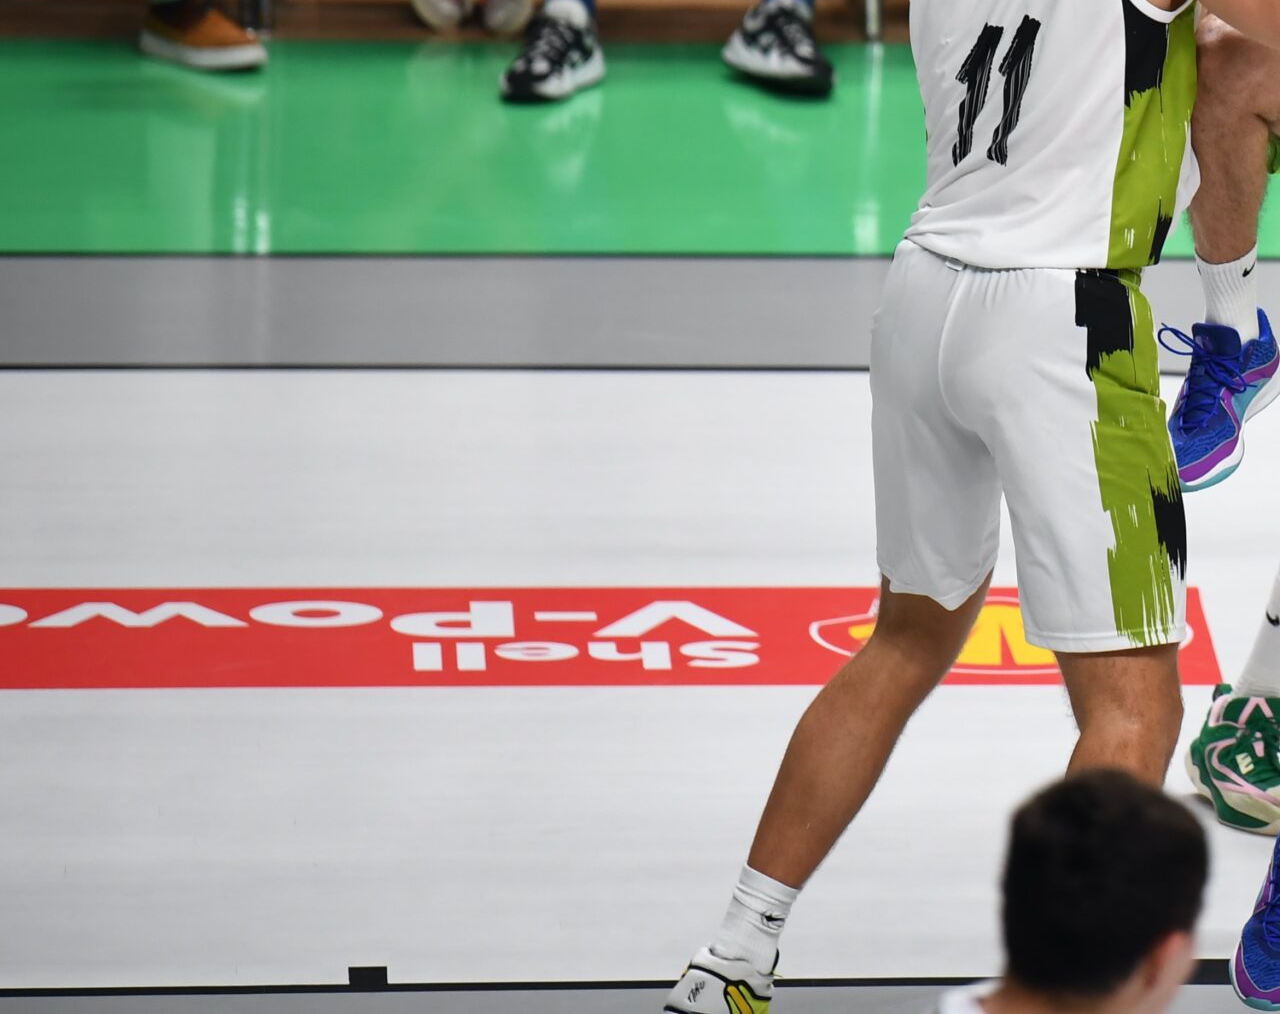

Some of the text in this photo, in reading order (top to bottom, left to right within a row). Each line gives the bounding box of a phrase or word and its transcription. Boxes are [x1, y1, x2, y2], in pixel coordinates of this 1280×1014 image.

[952, 14, 1041, 167] 11
[0, 600, 760, 638] V-Pow
[412, 640, 761, 671] Shell
